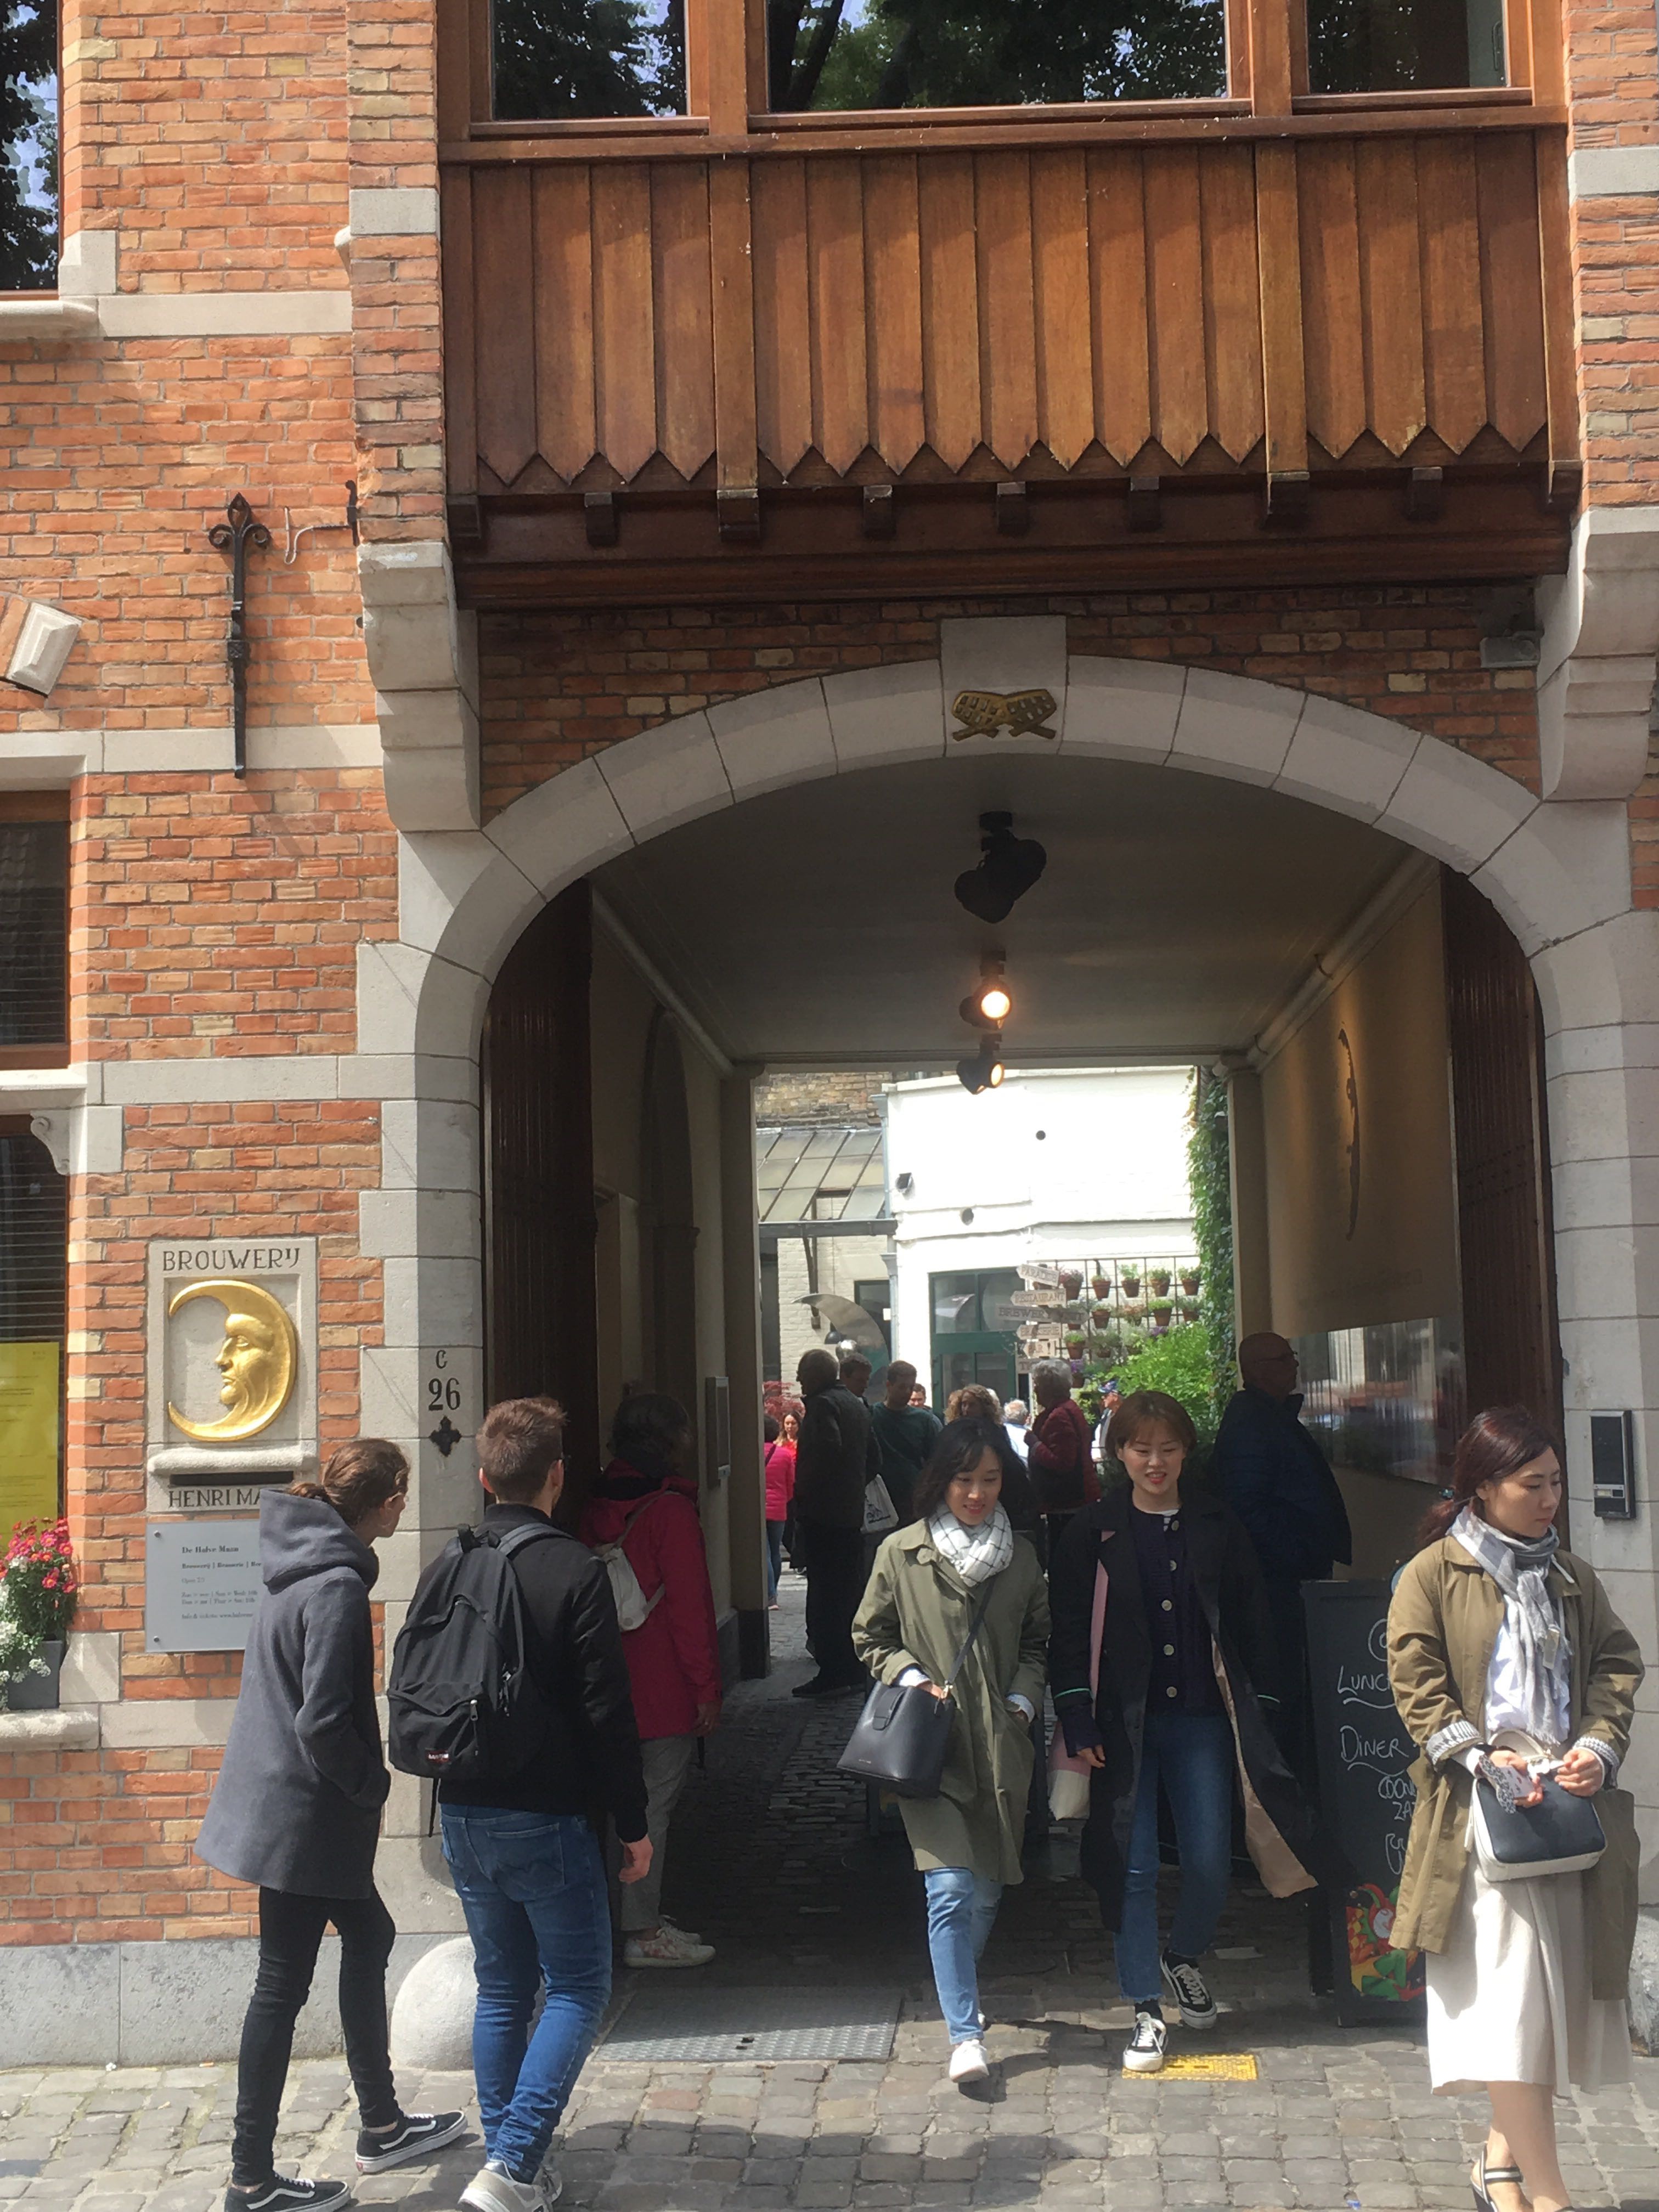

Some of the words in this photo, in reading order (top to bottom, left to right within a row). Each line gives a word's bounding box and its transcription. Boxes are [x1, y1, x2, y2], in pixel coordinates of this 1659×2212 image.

[163, 1248, 300, 1271] BROUWERIJ
[1015, 1291, 1065, 1304] RESTAURANT
[436, 1350, 448, 1369] C
[428, 1378, 461, 1411] 26
[168, 1488, 231, 1508] HENRI
